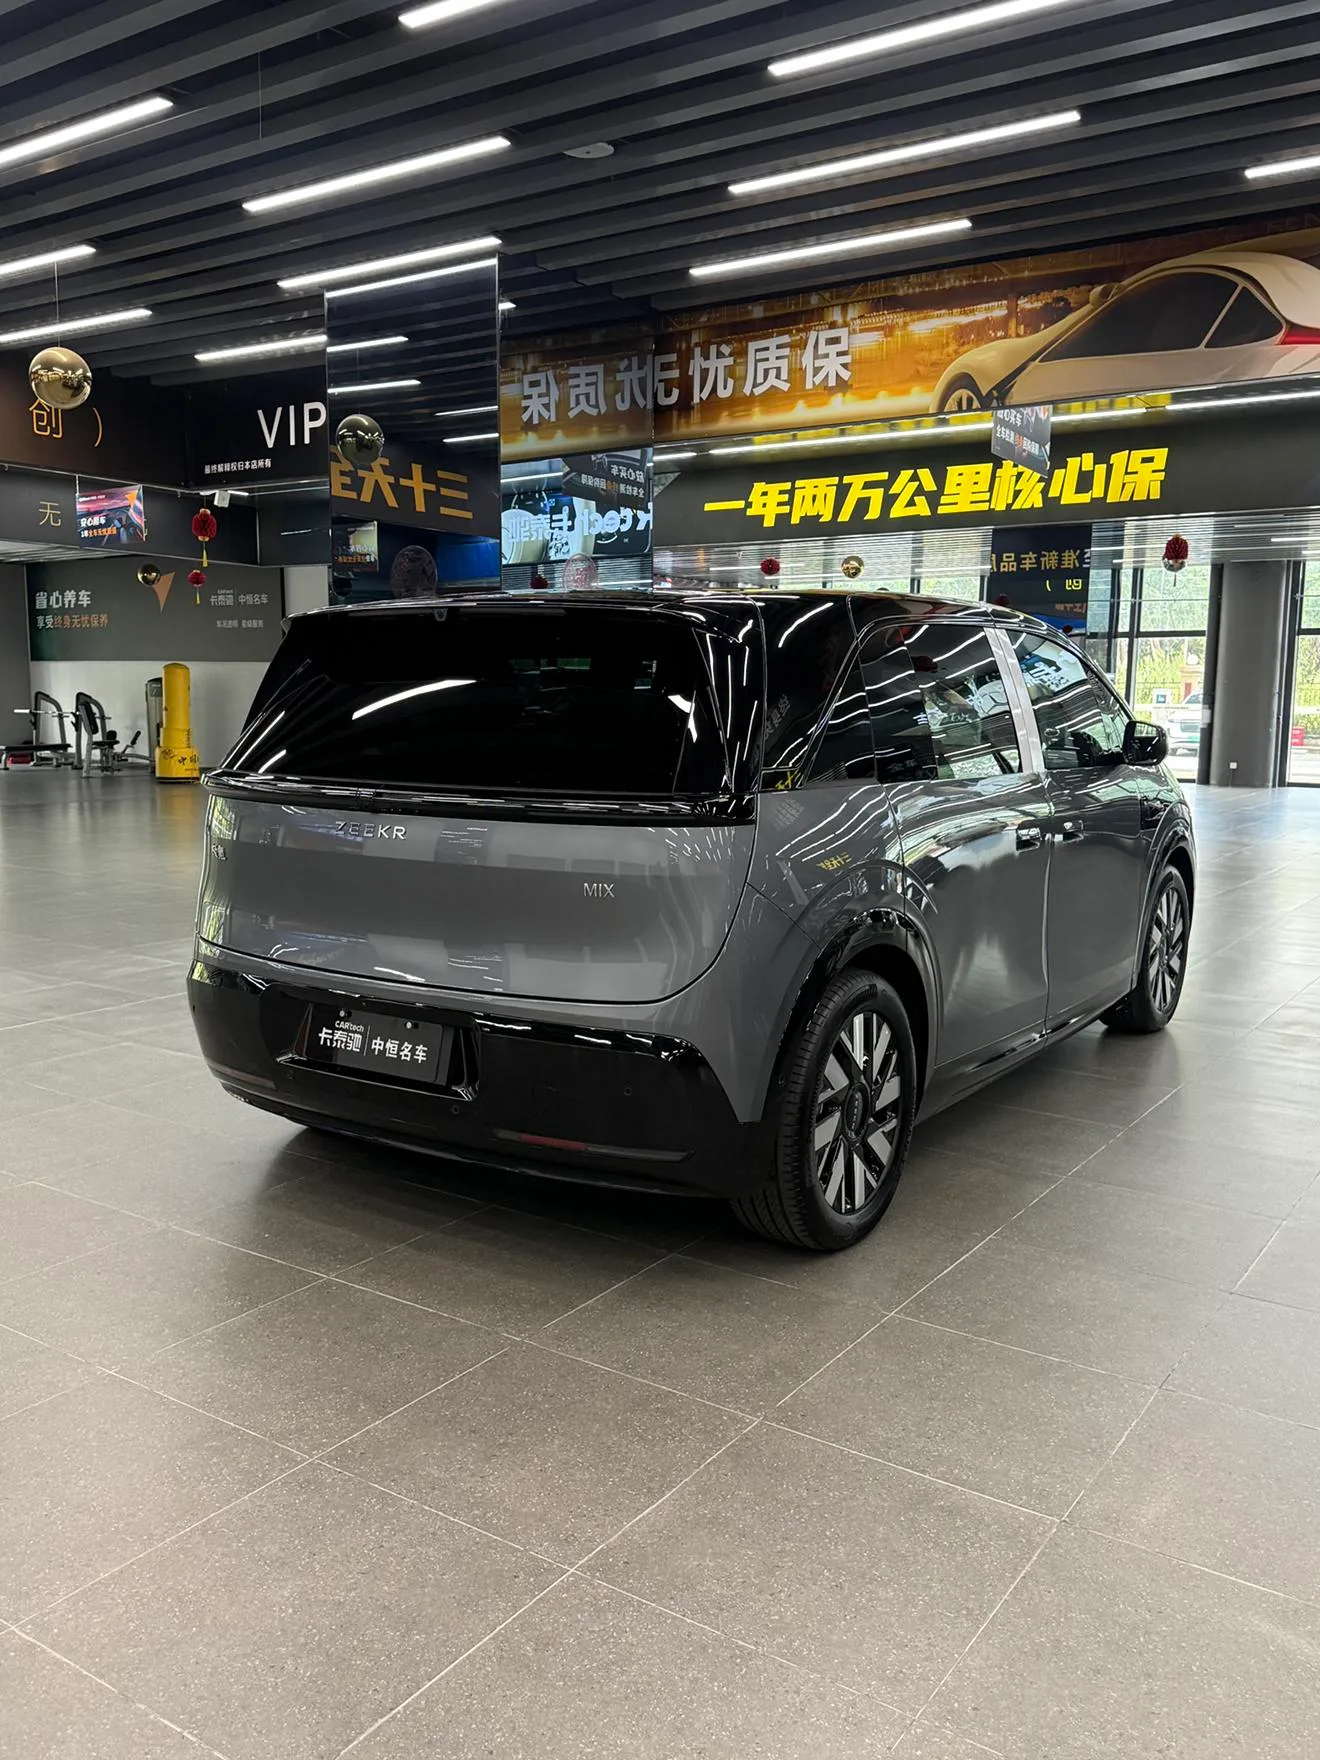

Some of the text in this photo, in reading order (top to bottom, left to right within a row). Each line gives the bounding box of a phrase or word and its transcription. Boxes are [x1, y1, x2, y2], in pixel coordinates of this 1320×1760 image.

[257, 401, 327, 449] VIP
[704, 447, 1169, 527] 一年两万公里核心保
[39, 501, 61, 527] 无
[35, 589, 92, 610] 省心养车
[335, 821, 408, 840] ZEEKR
[583, 882, 615, 898] MIX
[318, 1026, 428, 1064] 卡泰驰 中恒名车
